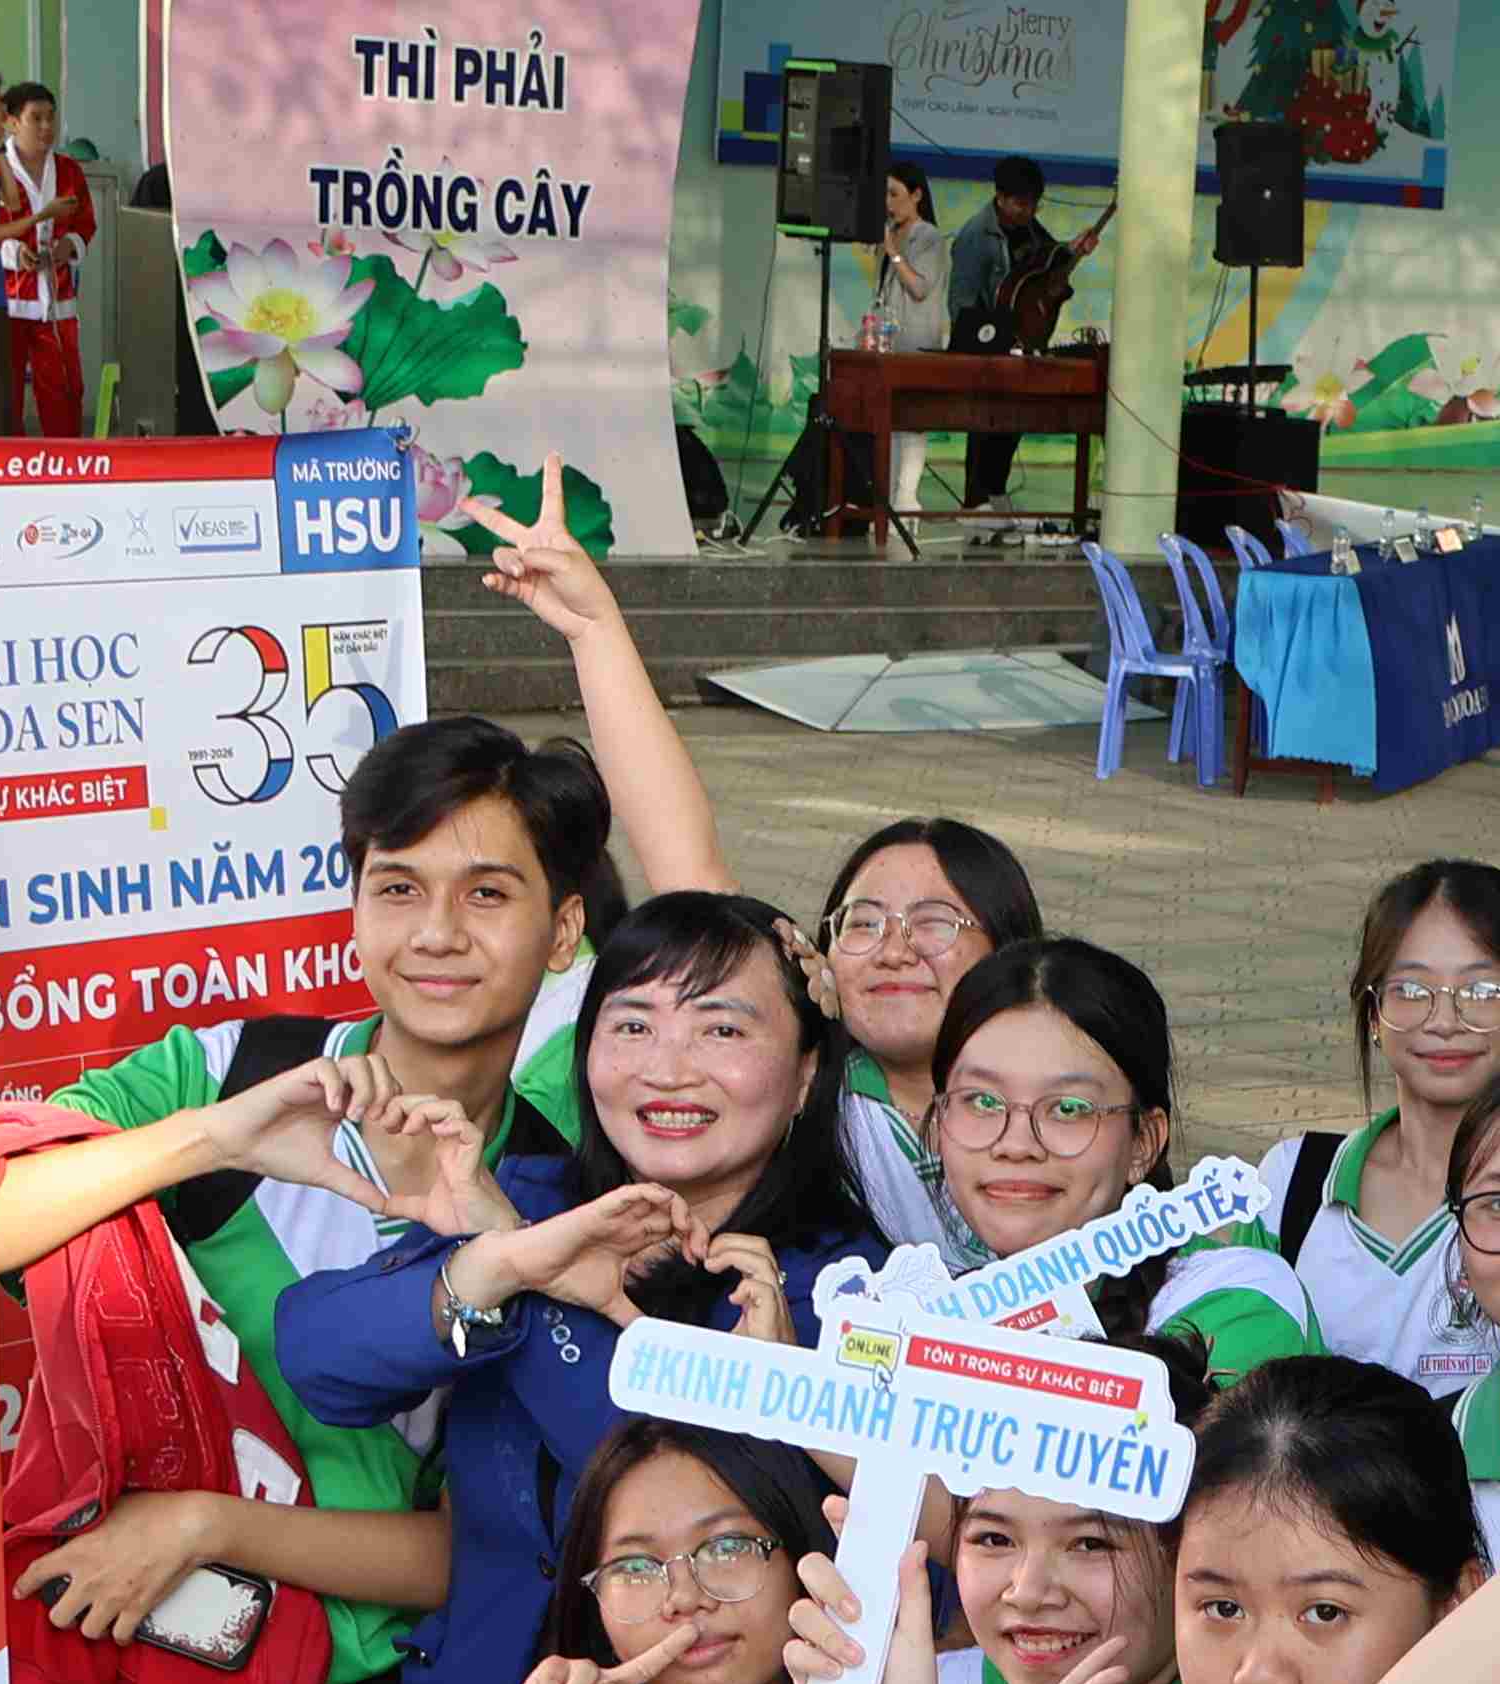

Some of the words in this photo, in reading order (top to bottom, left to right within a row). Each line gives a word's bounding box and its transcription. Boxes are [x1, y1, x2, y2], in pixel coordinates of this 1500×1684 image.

[355, 28, 438, 104] THÌ
[453, 32, 566, 112] PHẢI
[310, 146, 480, 234] TRỒNG
[495, 171, 593, 239] CÂY
[293, 460, 321, 483] MÃ
[326, 456, 401, 482] TRƯỜNG
[296, 498, 401, 556] HSU
[31, 631, 140, 691] HỌC
[53, 696, 146, 746] SEN
[15, 778, 78, 809] KHÁC
[81, 776, 129, 808] BIỆT
[28, 863, 153, 925] SINH
[169, 841, 285, 909] NĂM
[131, 946, 268, 1013] TOÀN
[969, 1242, 1092, 1318] DOANH
[1096, 1194, 1187, 1277] QUỐC
[1184, 1167, 1235, 1227] TẾ
[843, 1336, 893, 1361] ONLINE
[922, 1343, 955, 1366] TÔN
[957, 1351, 1013, 1380] TRỌNG
[1015, 1361, 1038, 1384] SỰ
[1041, 1363, 1083, 1391] KHÁC
[1086, 1373, 1125, 1402] BIỆT
[627, 1341, 750, 1411] #KINH
[760, 1371, 896, 1443] DOANH
[911, 1397, 1018, 1475] TRỰC
[1034, 1410, 1170, 1500] TUYẾN
